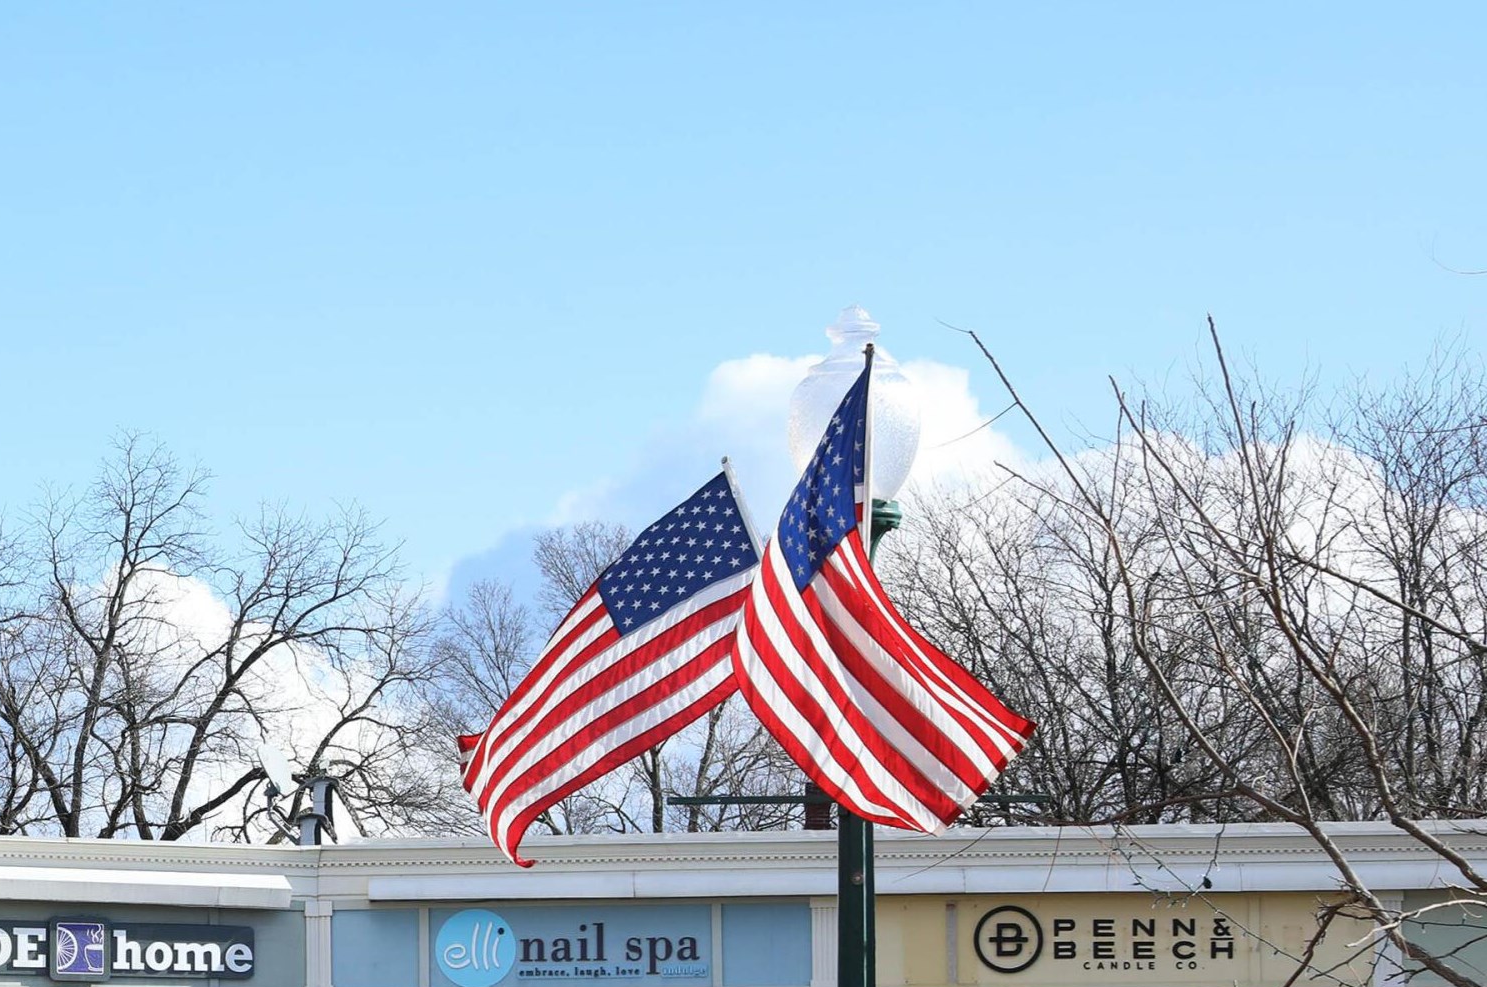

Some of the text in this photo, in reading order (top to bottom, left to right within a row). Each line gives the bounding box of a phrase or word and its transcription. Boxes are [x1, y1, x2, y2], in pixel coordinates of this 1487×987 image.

[1053, 918, 1231, 937] PENN &
[113, 930, 253, 973] home
[444, 921, 505, 970] elli
[519, 923, 700, 975] nail spa
[1053, 941, 1234, 959] BEECH
[616, 966, 641, 976] love
[1083, 961, 1156, 970] CANDLE
